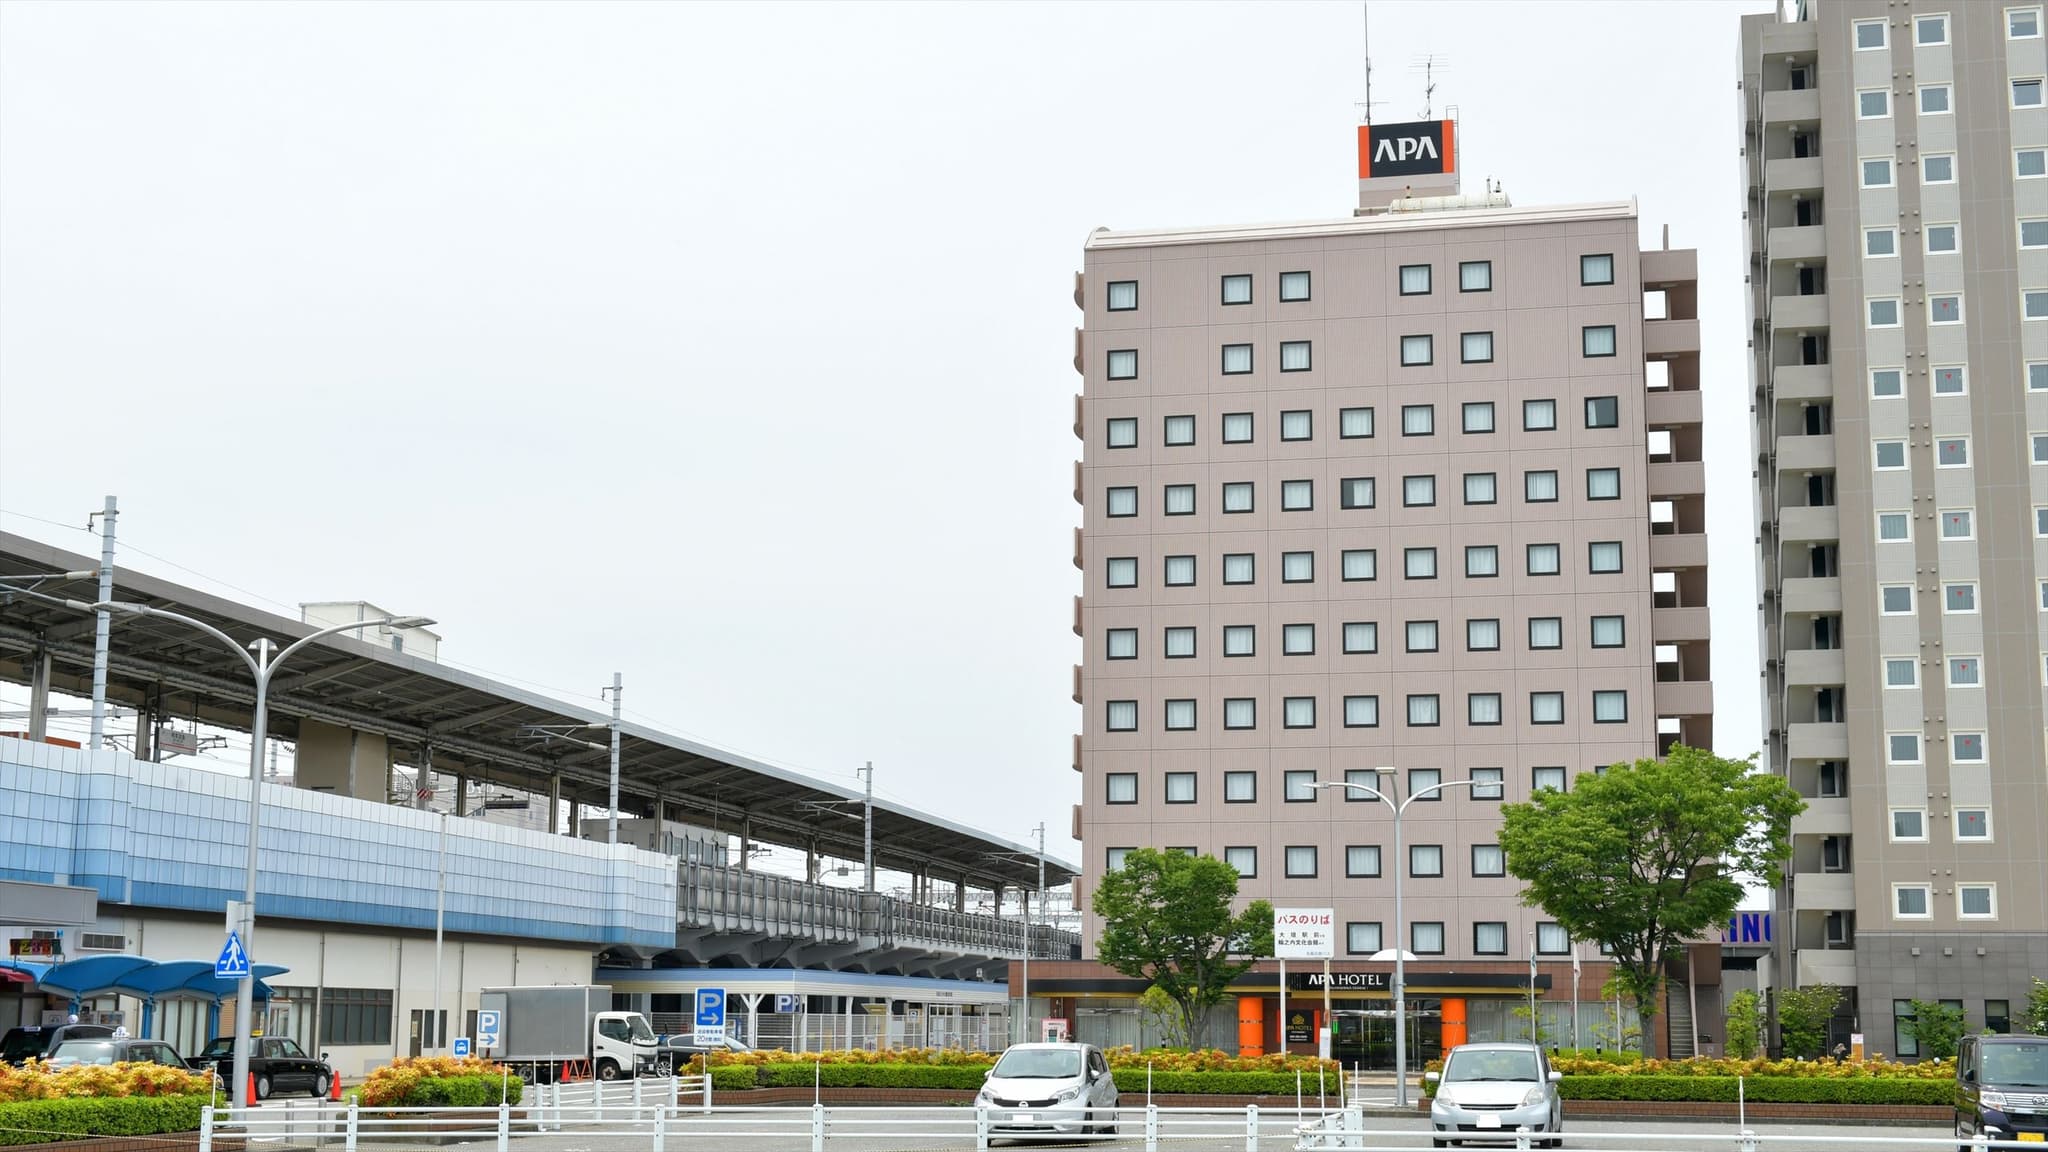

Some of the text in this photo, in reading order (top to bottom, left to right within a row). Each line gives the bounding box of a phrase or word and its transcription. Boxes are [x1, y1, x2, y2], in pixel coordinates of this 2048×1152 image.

[1374, 136, 1438, 163] APA
[1278, 914, 1330, 925] バスのりば
[1308, 974, 1383, 985] APA HOTEL
[699, 992, 721, 1014] P
[777, 995, 792, 1011] P
[481, 1014, 496, 1032] P
